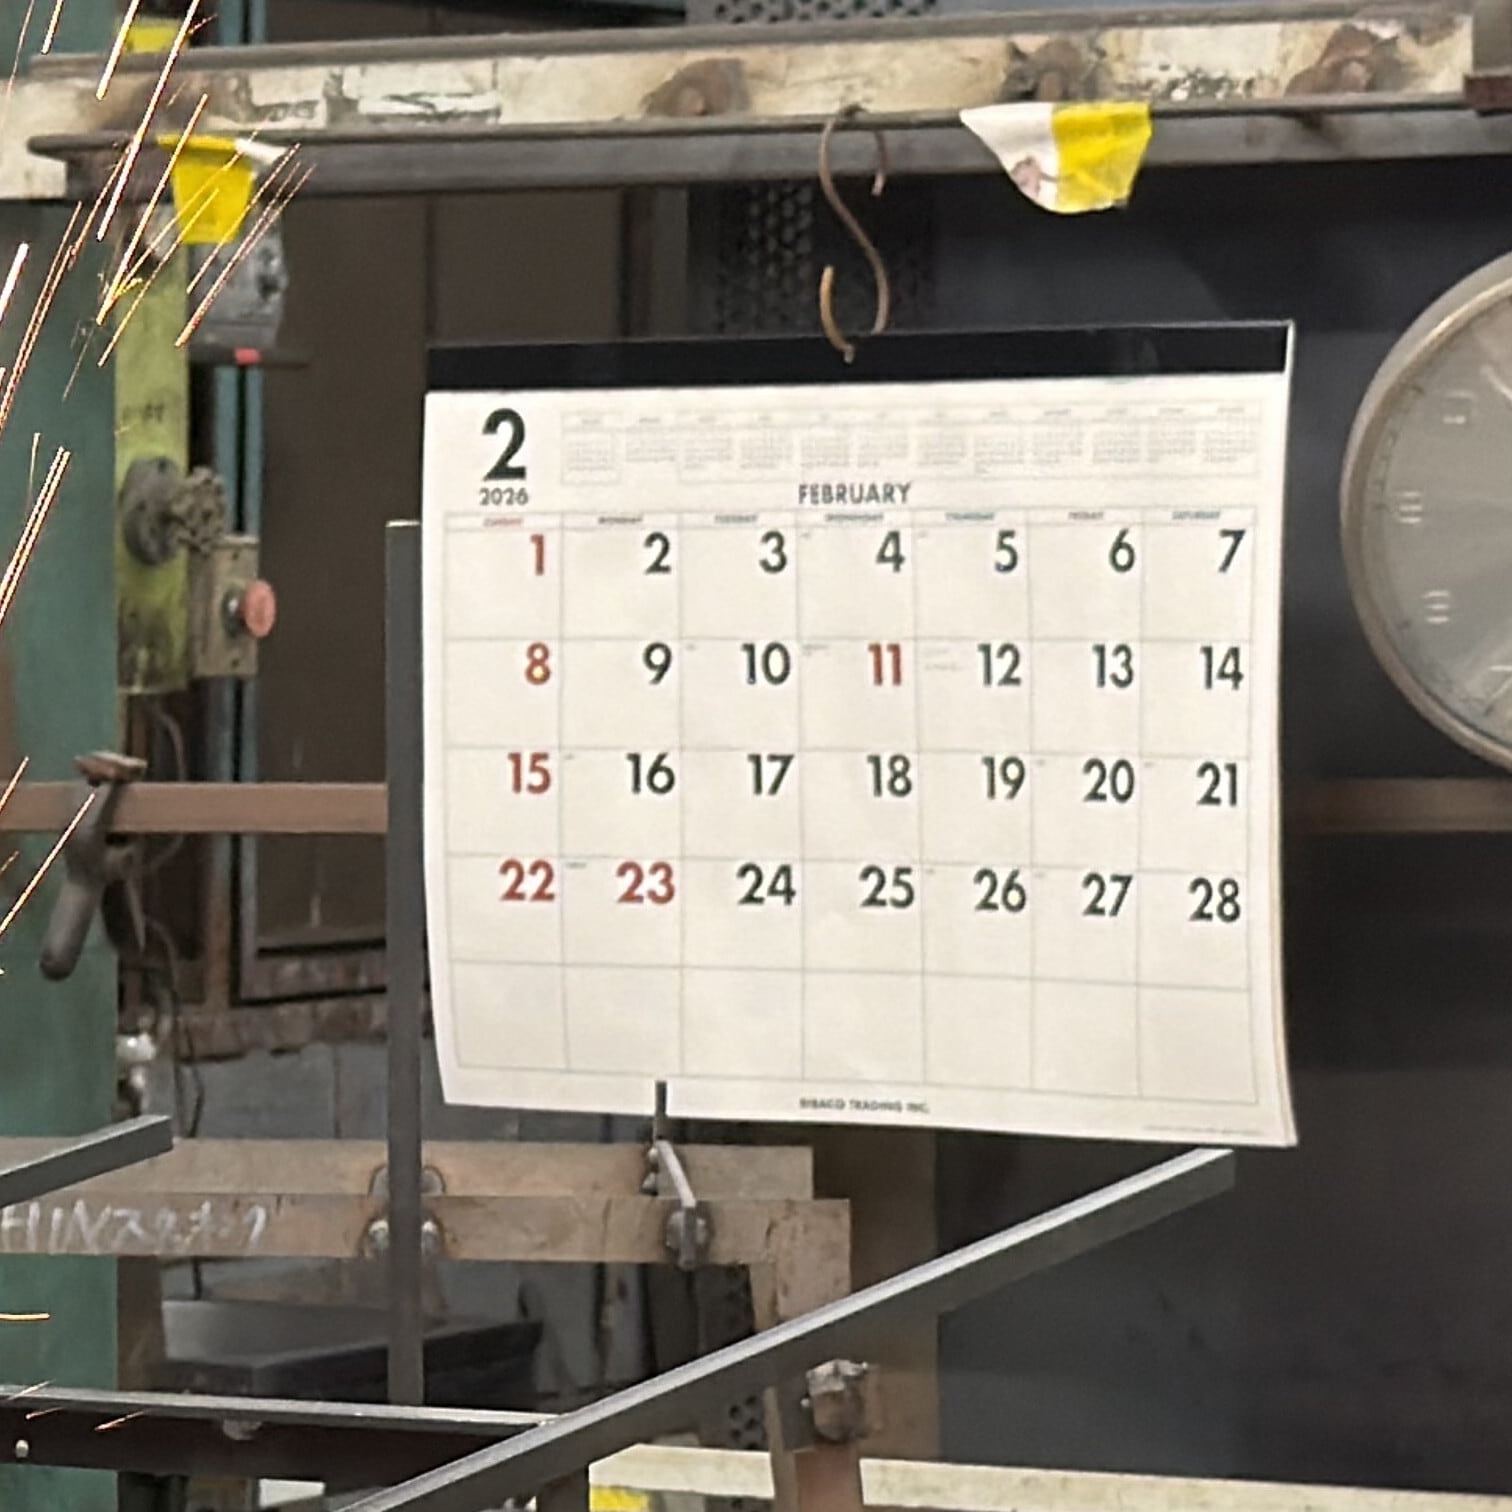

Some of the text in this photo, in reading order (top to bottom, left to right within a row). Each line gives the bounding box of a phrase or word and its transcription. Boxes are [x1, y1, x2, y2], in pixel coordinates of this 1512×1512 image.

[482, 406, 527, 482] 2
[479, 487, 529, 506] 2026
[798, 482, 911, 505] FEBRUARY
[531, 528, 1246, 577] 1 2 3 4 5 6 7
[525, 642, 551, 687] 8
[643, 642, 672, 686] 9
[742, 642, 791, 686] 10
[868, 642, 903, 687] 11
[978, 643, 1022, 687] 12
[1093, 643, 1134, 689] 13
[1201, 645, 1244, 690] 14
[508, 752, 1238, 807] 15 16 17 18 19 20 21
[499, 858, 1241, 923] 22 23 24 25 26 27 28
